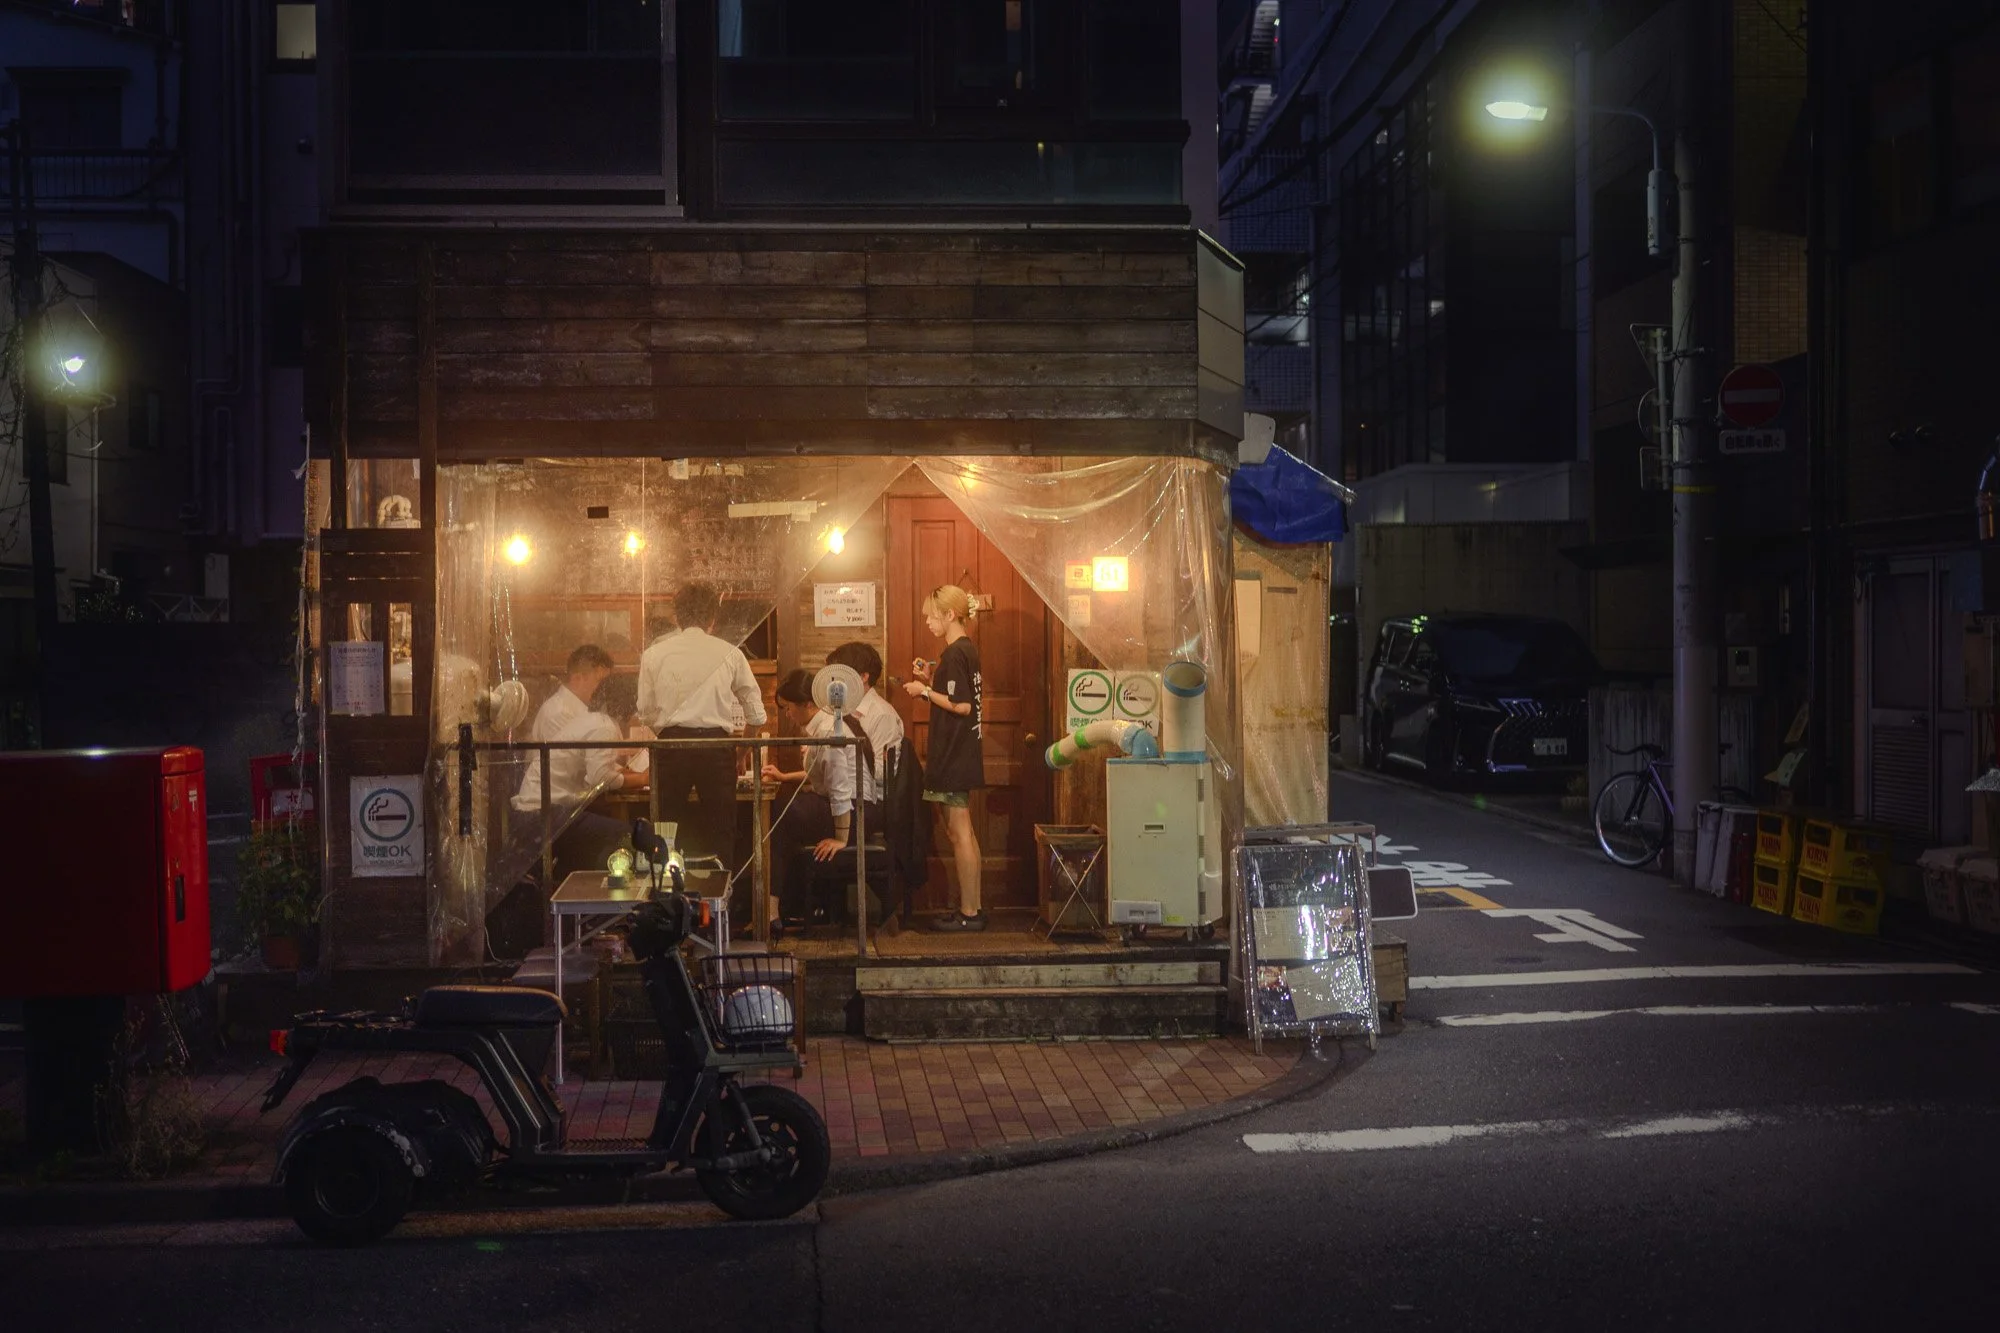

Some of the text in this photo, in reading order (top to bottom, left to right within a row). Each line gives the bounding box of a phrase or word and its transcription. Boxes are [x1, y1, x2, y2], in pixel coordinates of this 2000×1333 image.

[363, 844, 412, 858] 喫煙OK
[1761, 836, 1781, 850] KIRIN
[1806, 845, 1829, 864] KIRIN
[1758, 885, 1778, 902] KIRIN
[1799, 896, 1821, 916] KIRIN
